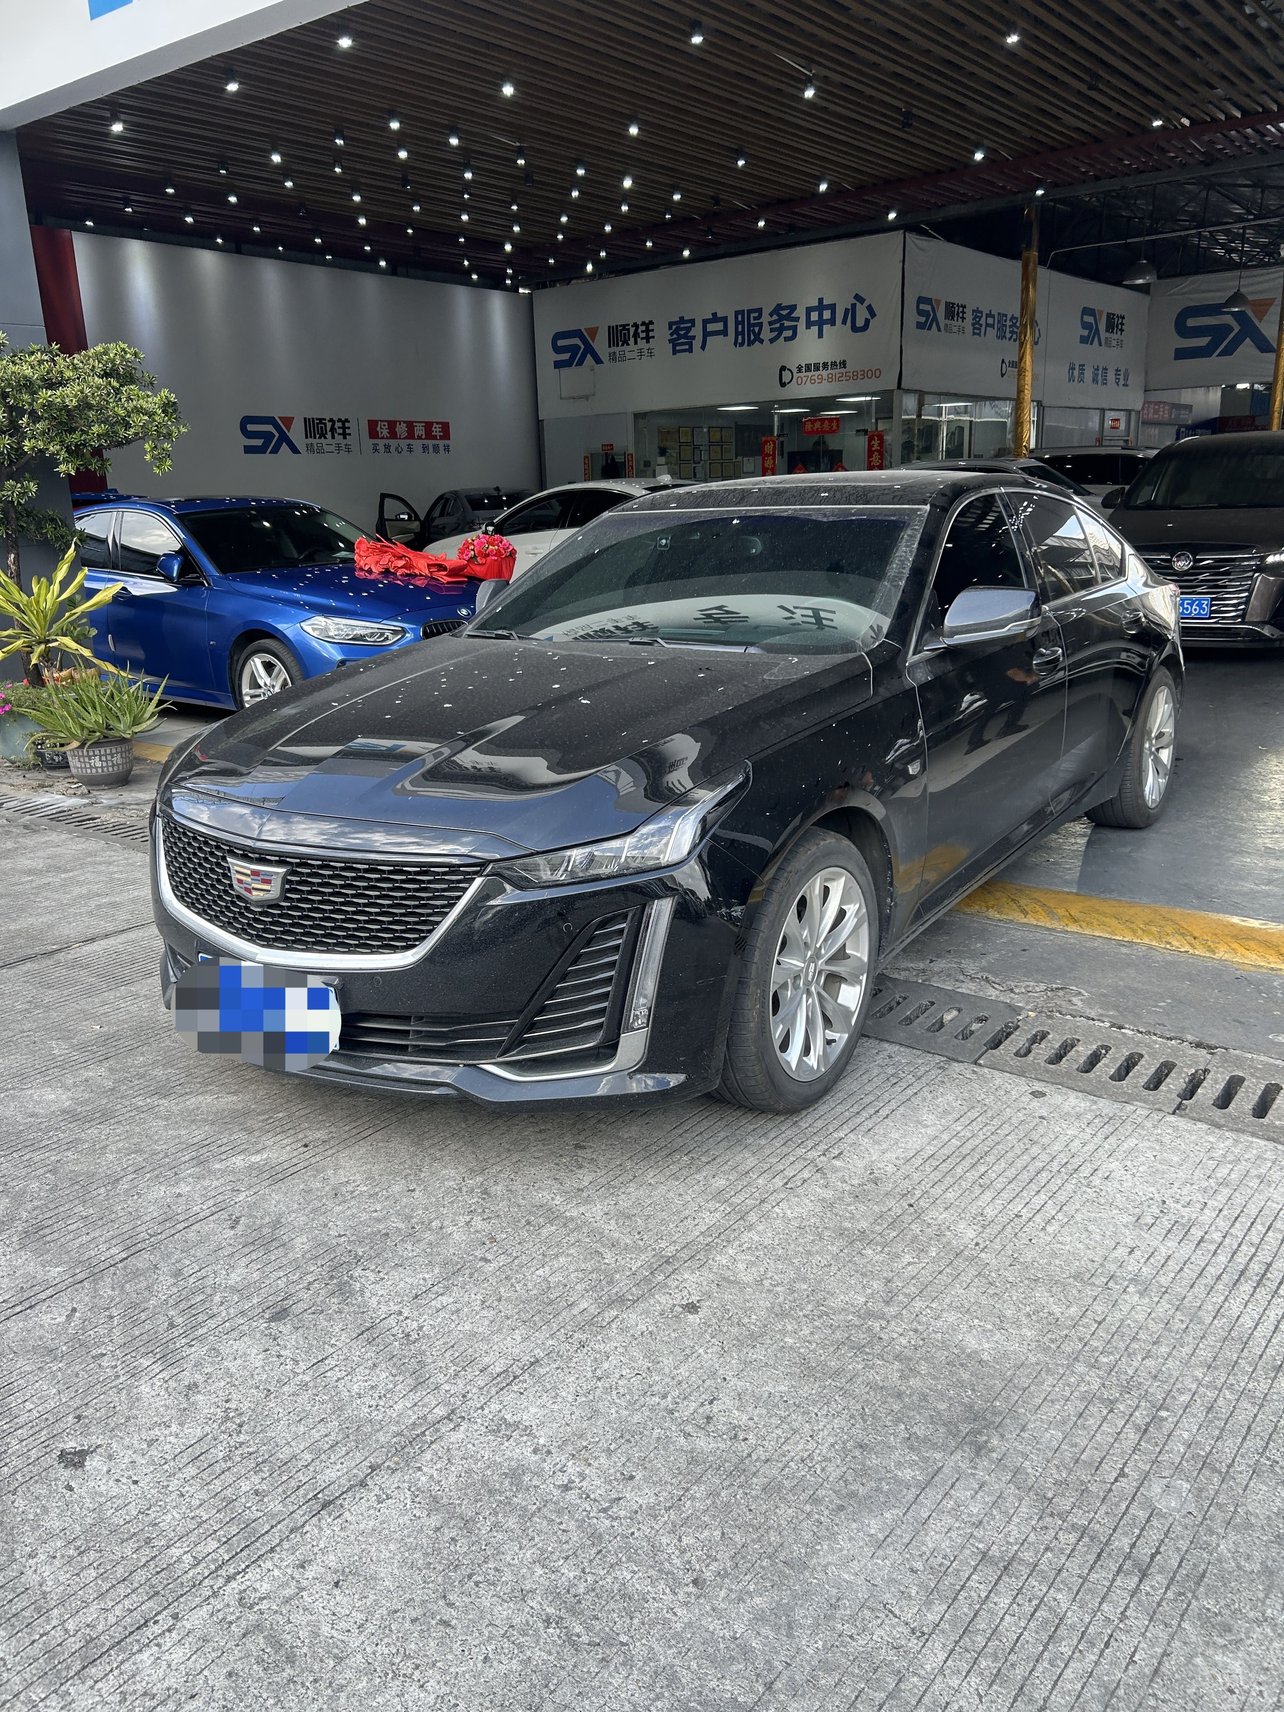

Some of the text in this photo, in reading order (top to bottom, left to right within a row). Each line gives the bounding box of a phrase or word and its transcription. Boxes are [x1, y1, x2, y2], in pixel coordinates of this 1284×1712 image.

[668, 293, 877, 355] 客户服务中心
[915, 295, 942, 333] SX
[944, 300, 967, 324] 顺祥
[1104, 311, 1126, 337] 顺祥
[607, 320, 655, 349] 顺祥
[971, 307, 1041, 346] 客户服务心
[1079, 306, 1104, 347] SX
[551, 326, 604, 369] SX
[608, 347, 656, 364] 精品二手车
[795, 359, 848, 374] 全国服务热线
[796, 368, 882, 386] 0769-81258300
[1067, 362, 1130, 388] 优质 诚信 专业
[239, 415, 302, 455] SX
[303, 416, 352, 440] 顺祥
[376, 421, 444, 439] 保修两年
[305, 442, 353, 455] 精品二手车
[372, 442, 452, 455] 买放心车 到顺祥
[869, 436, 882, 469] 生意
